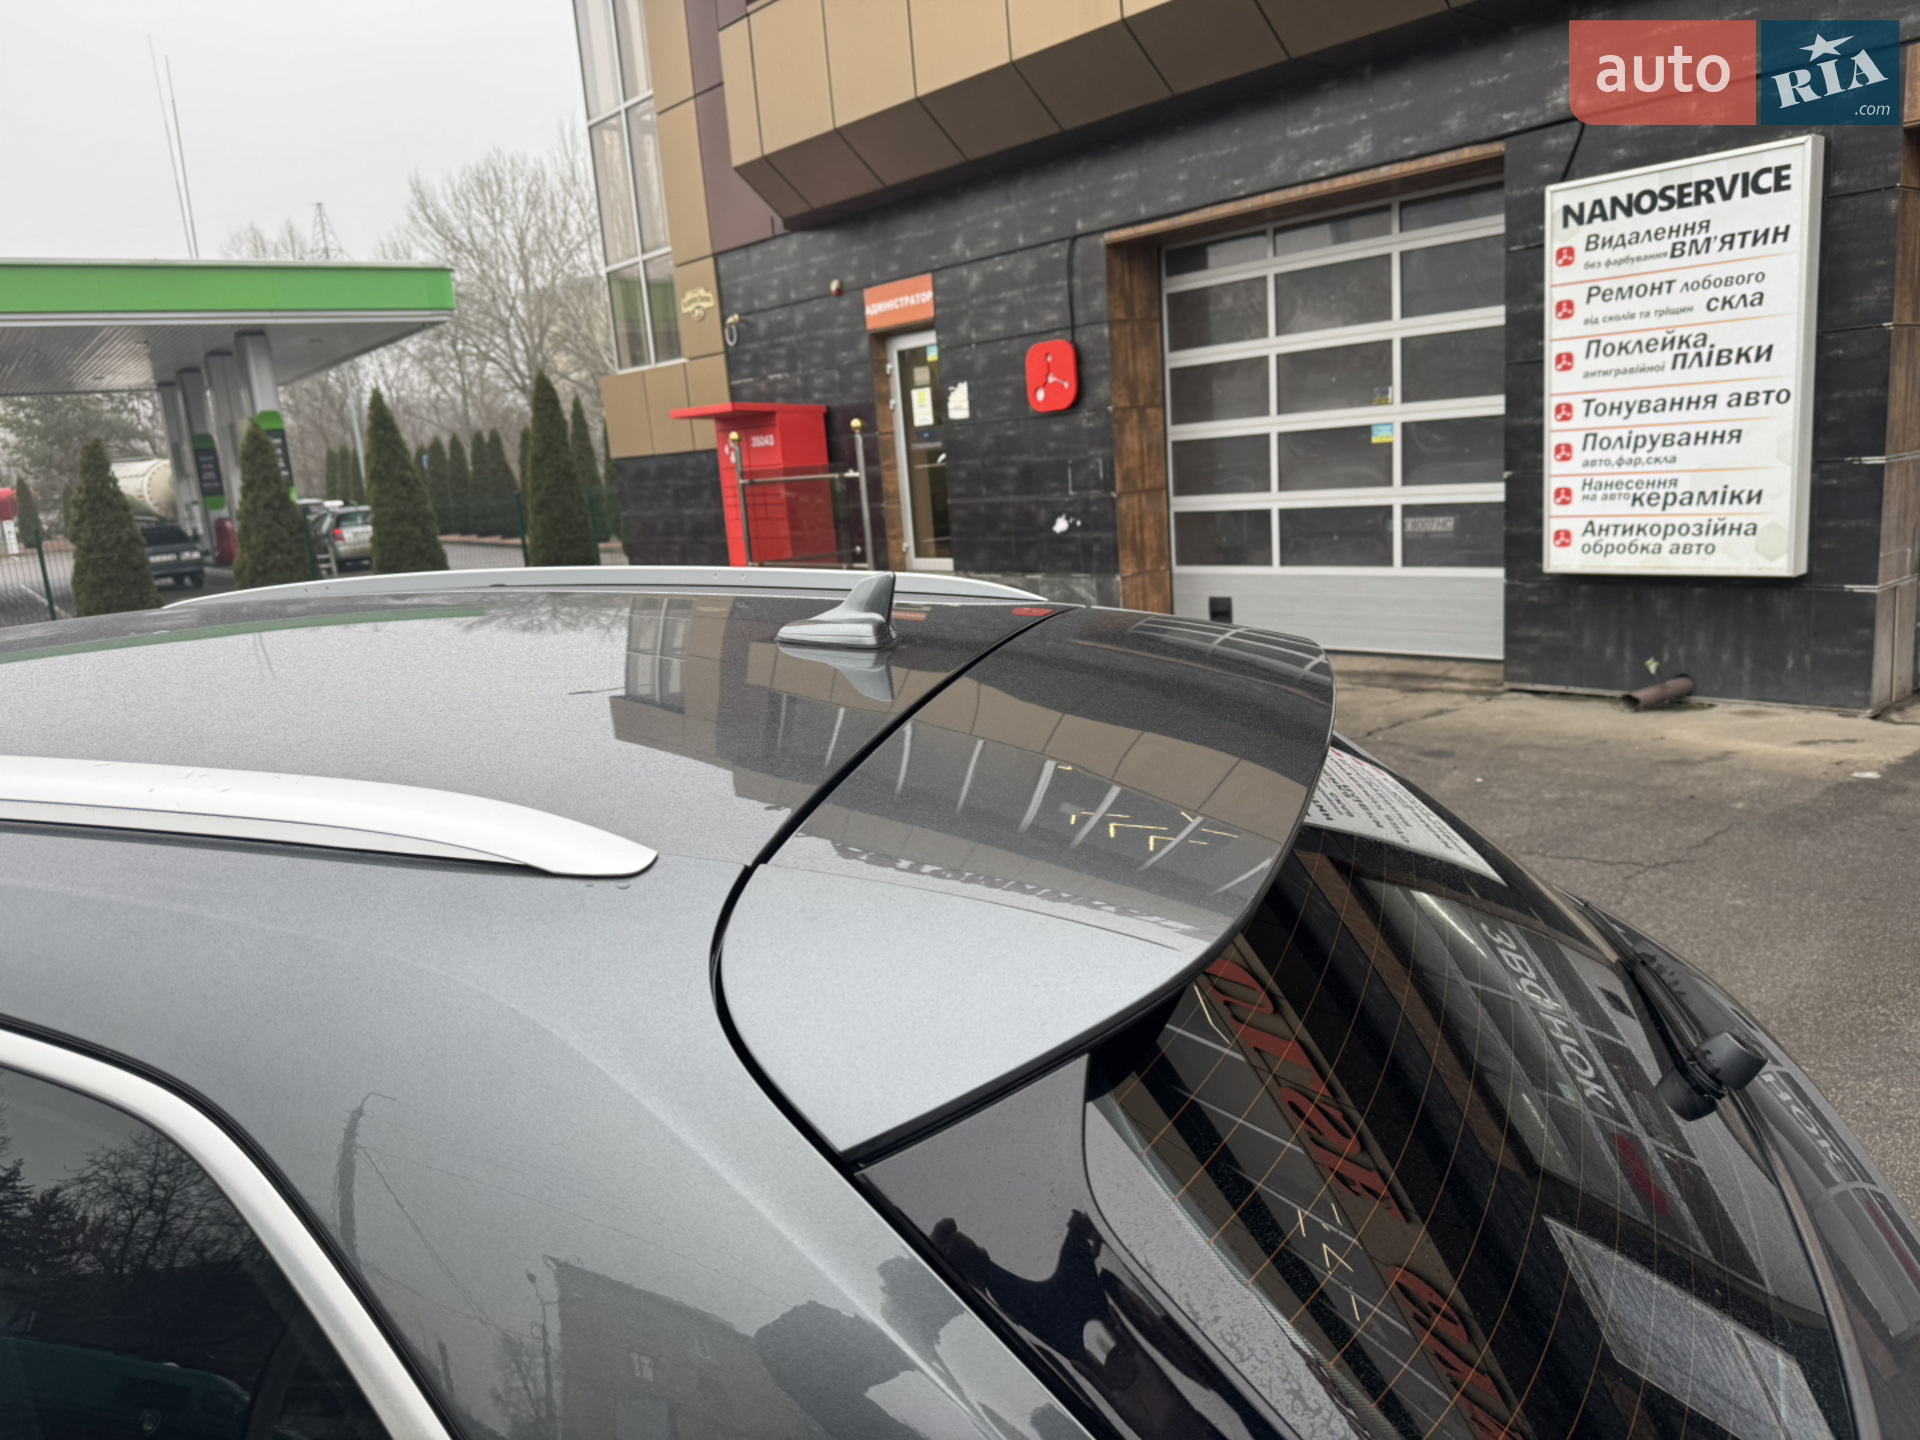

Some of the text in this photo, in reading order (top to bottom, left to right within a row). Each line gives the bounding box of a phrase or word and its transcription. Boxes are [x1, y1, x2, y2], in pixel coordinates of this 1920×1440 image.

[1562, 164, 1792, 229] NANOSERVICE
[1584, 219, 1711, 252] Видалення
[1584, 251, 1668, 270] без фарбування
[1585, 271, 1766, 305] Ремонт лобового
[1638, 309, 1651, 320] та
[1653, 304, 1694, 319] тріщин
[1705, 291, 1765, 313] скла
[1585, 330, 1708, 360] Поклейка
[1670, 344, 1774, 371] плівки
[1582, 362, 1666, 379] антигравійної
[1582, 388, 1791, 420] Тонування авто
[1581, 428, 1743, 454] Полірування
[1581, 477, 1678, 492] Нанесення
[1581, 491, 1631, 502] на авто
[1630, 485, 1763, 511] кераміки
[1581, 518, 1758, 541] Антикорозійна
[1581, 540, 1716, 557] обробка авто
